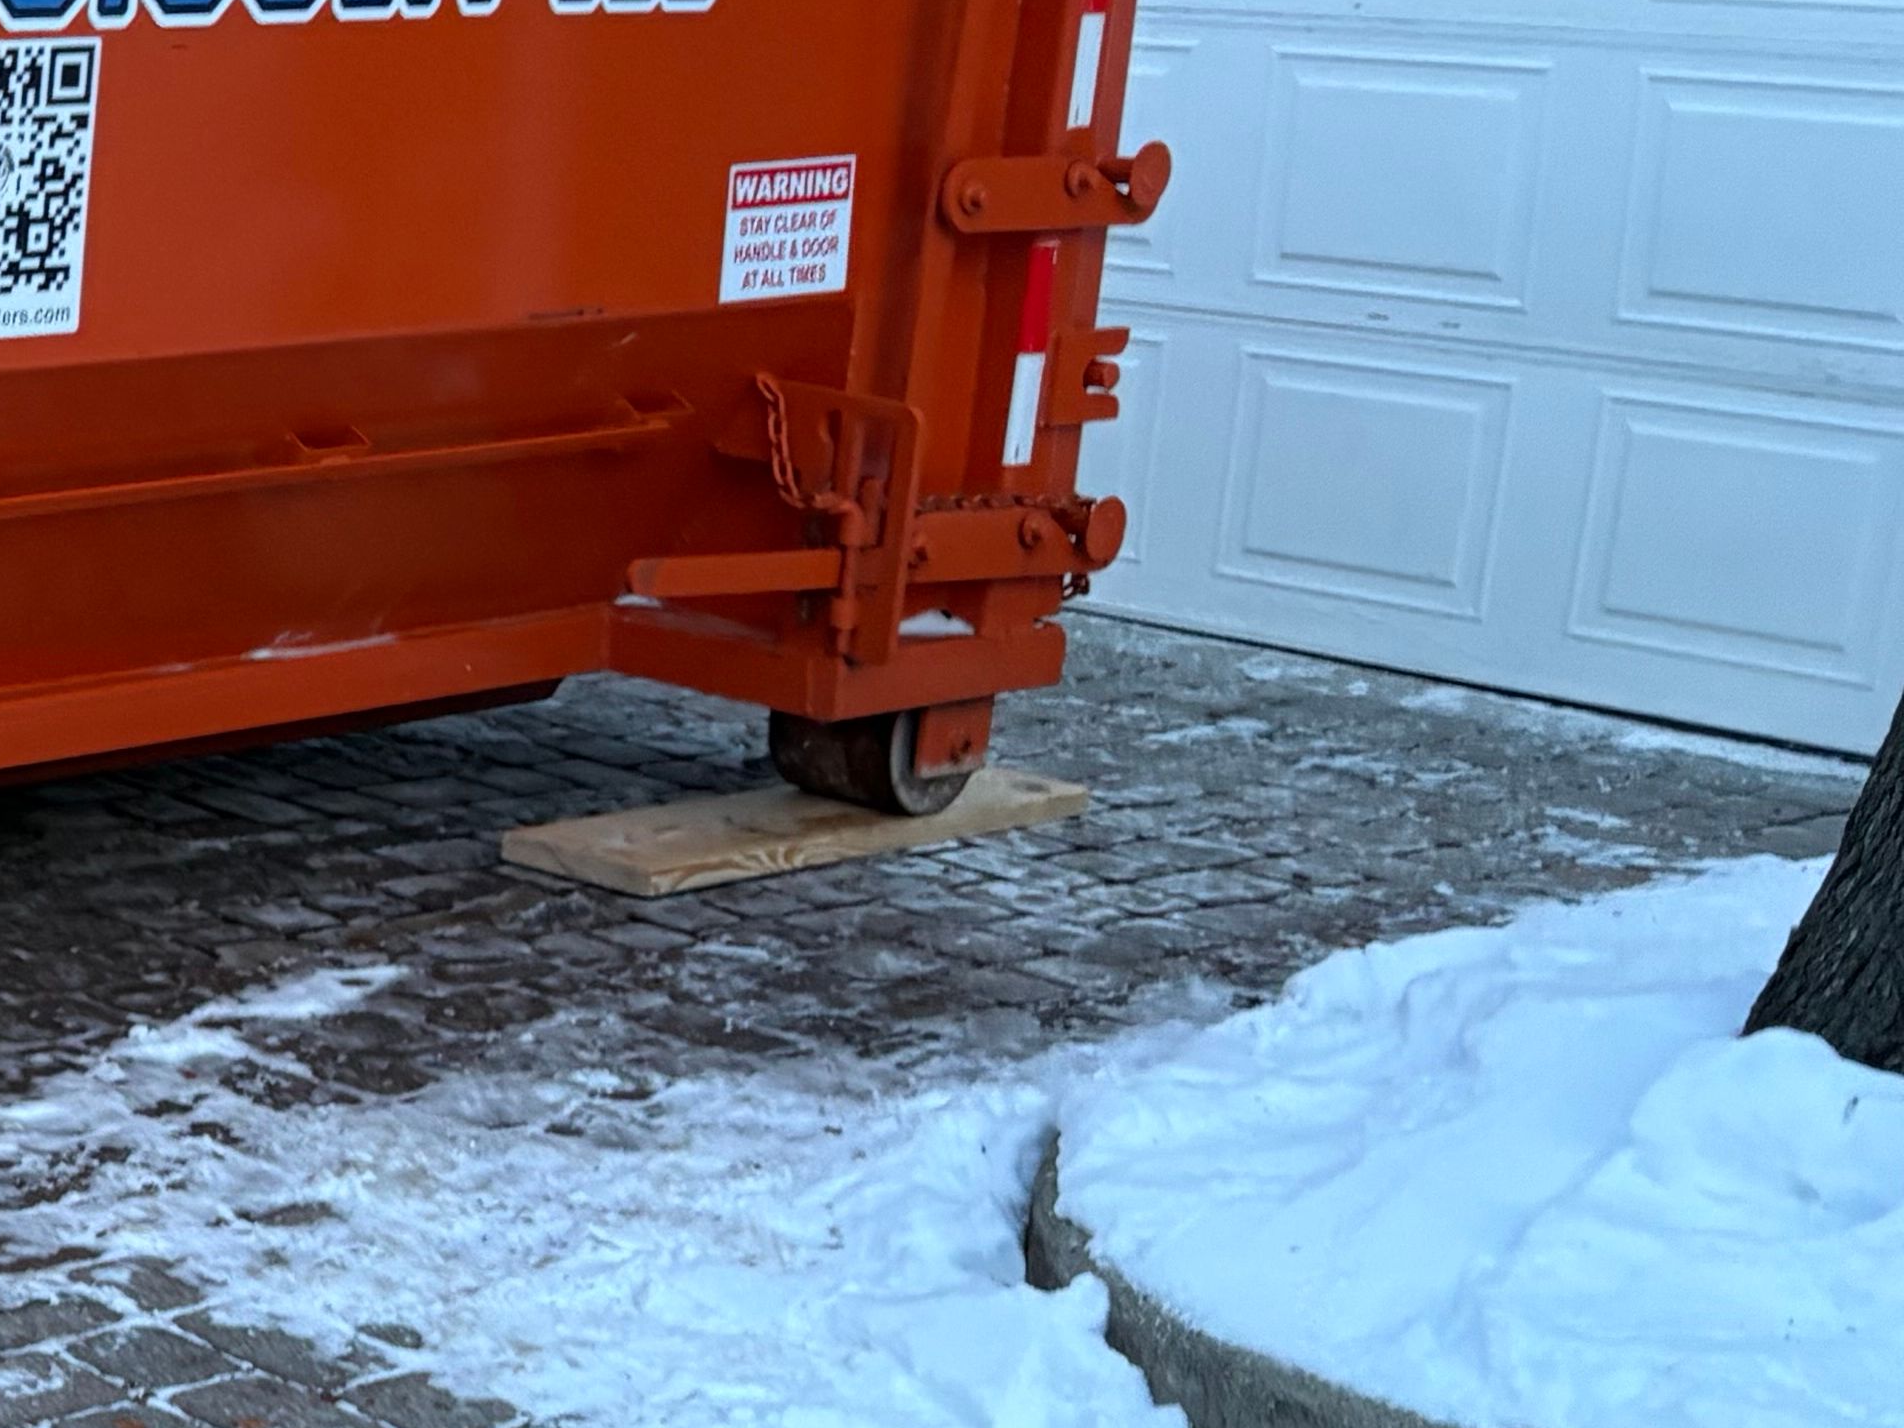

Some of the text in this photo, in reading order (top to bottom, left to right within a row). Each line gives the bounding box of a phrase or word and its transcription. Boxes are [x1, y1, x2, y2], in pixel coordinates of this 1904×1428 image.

[735, 167, 849, 205] WARNING
[739, 209, 837, 237] STAY CLEAR OF
[734, 239, 786, 263] HANDLE
[802, 235, 839, 259] DOOR
[742, 264, 826, 291] AT ALL TIMES
